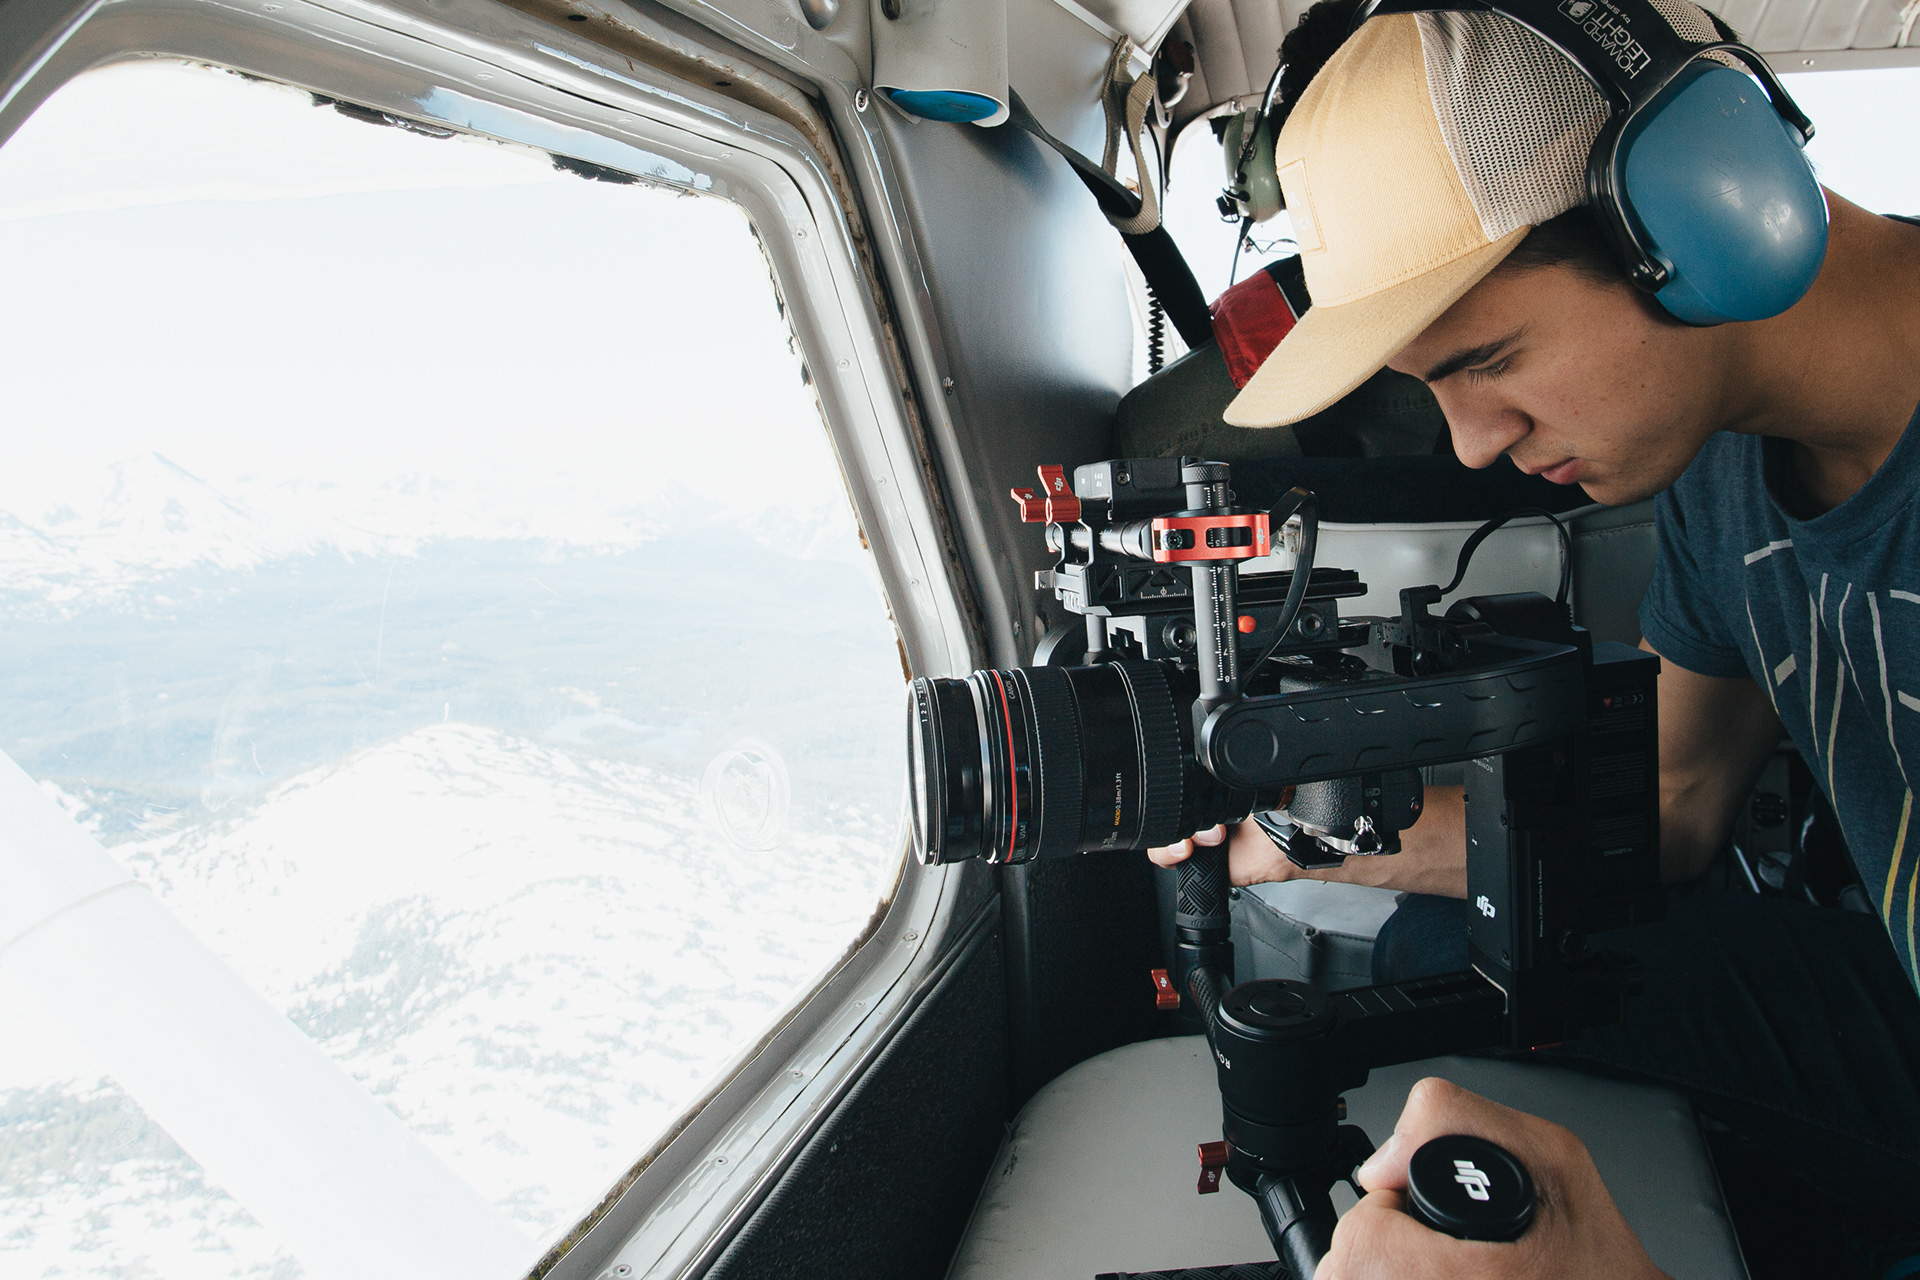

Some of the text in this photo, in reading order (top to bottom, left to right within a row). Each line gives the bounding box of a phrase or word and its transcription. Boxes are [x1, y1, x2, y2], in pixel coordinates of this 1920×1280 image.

[1620, 13, 1631, 24] by
[1583, 21, 1640, 79] HOWARD
[1591, 12, 1651, 70] LEIGHT
[1005, 680, 1016, 700] CANON
[1113, 808, 1122, 827] MACRO
[1019, 824, 1027, 840] USM
[1603, 847, 1634, 857] WARNING
